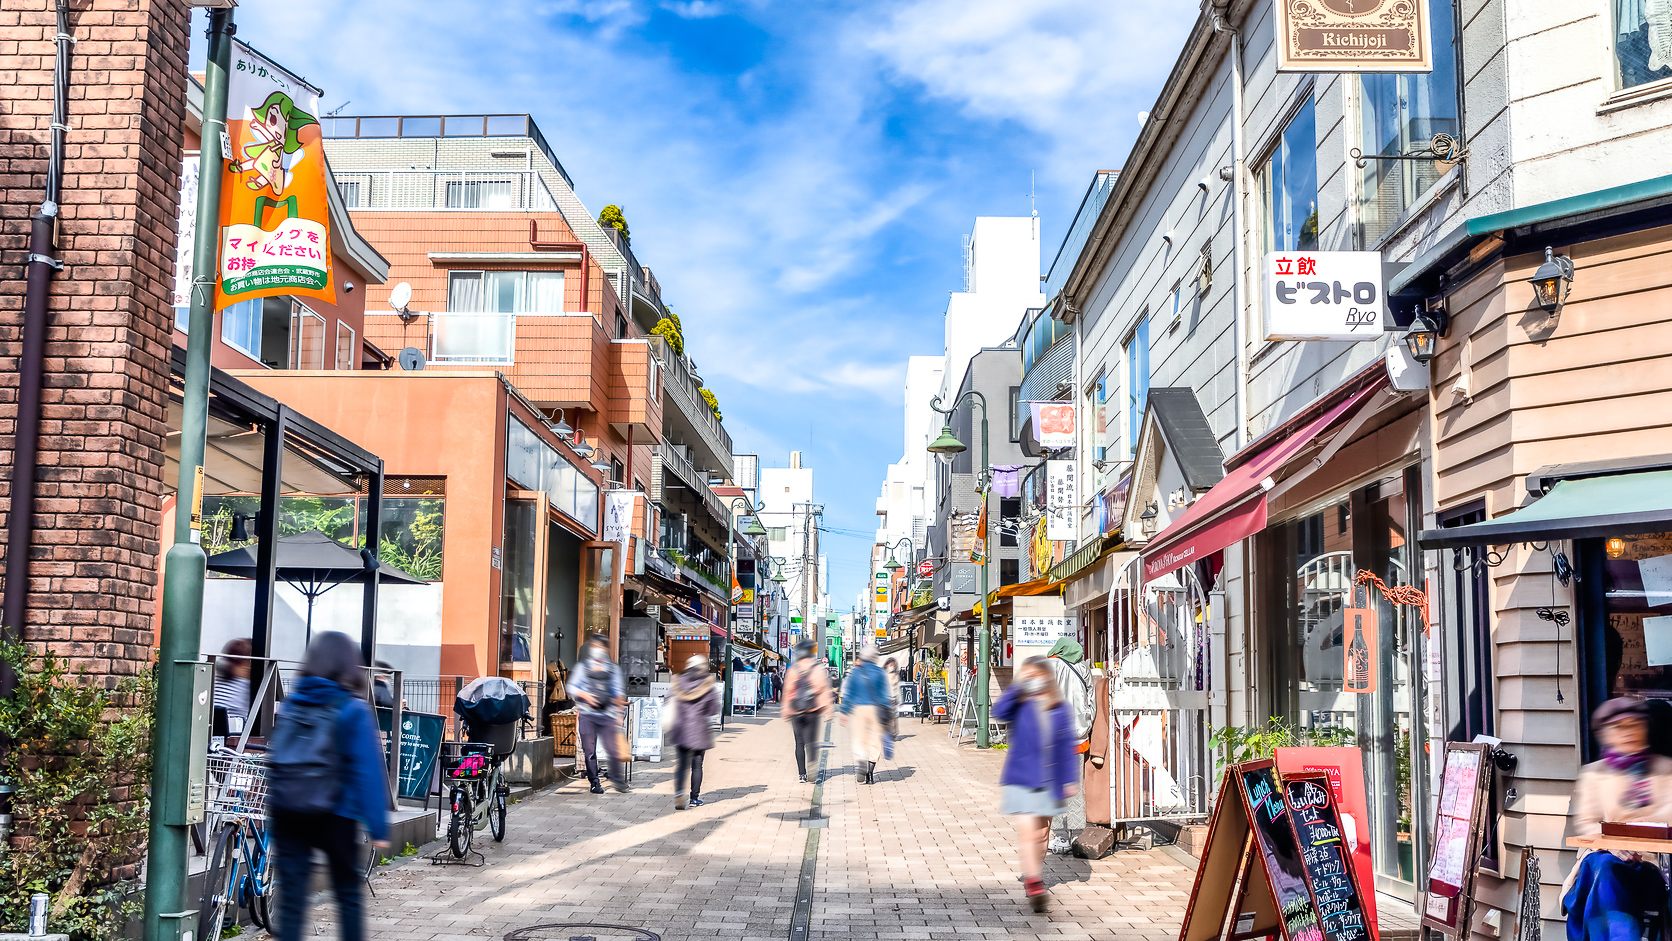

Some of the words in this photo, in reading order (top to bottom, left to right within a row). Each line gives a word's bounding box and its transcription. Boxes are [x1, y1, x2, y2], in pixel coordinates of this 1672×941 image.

[1322, 32, 1388, 48] Kichijoji
[1275, 256, 1317, 276] 立飲
[1276, 281, 1377, 304] ビストロ
[1345, 308, 1377, 332] Ryo
[1300, 806, 1319, 823] セット
